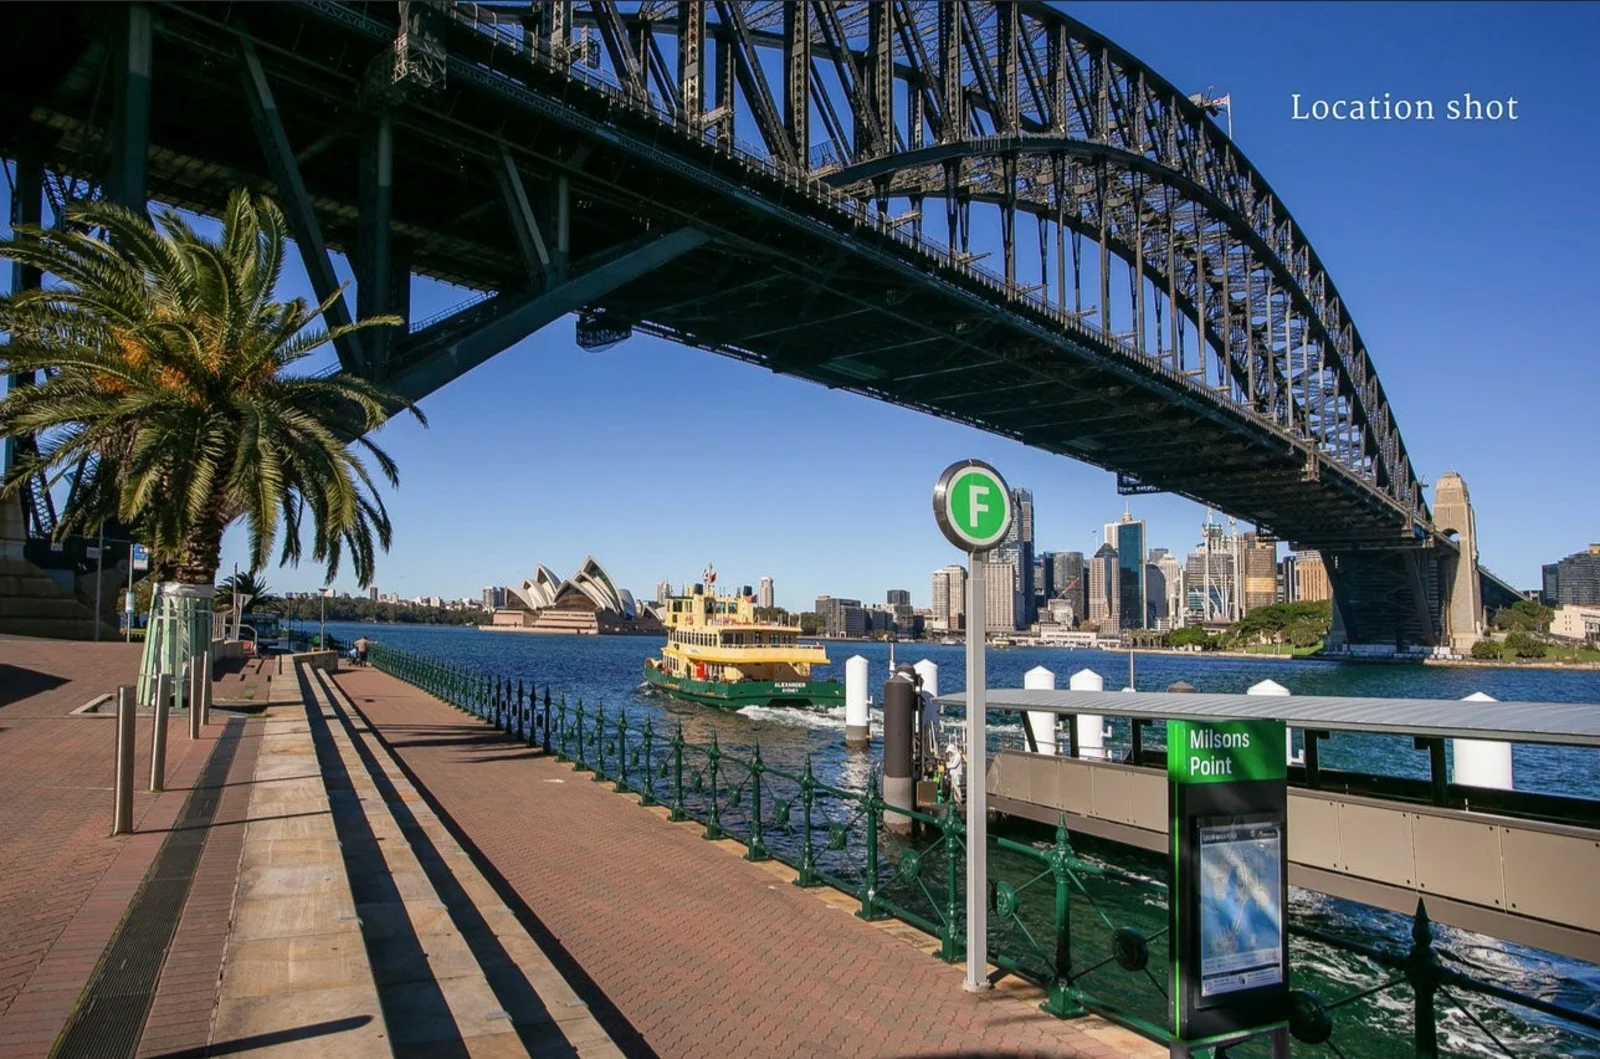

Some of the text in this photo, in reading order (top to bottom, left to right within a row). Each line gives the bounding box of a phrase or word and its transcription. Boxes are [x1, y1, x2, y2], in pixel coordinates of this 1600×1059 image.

[969, 484, 990, 528] F
[1190, 729, 1250, 749] Milsons
[1190, 755, 1232, 776] Point
